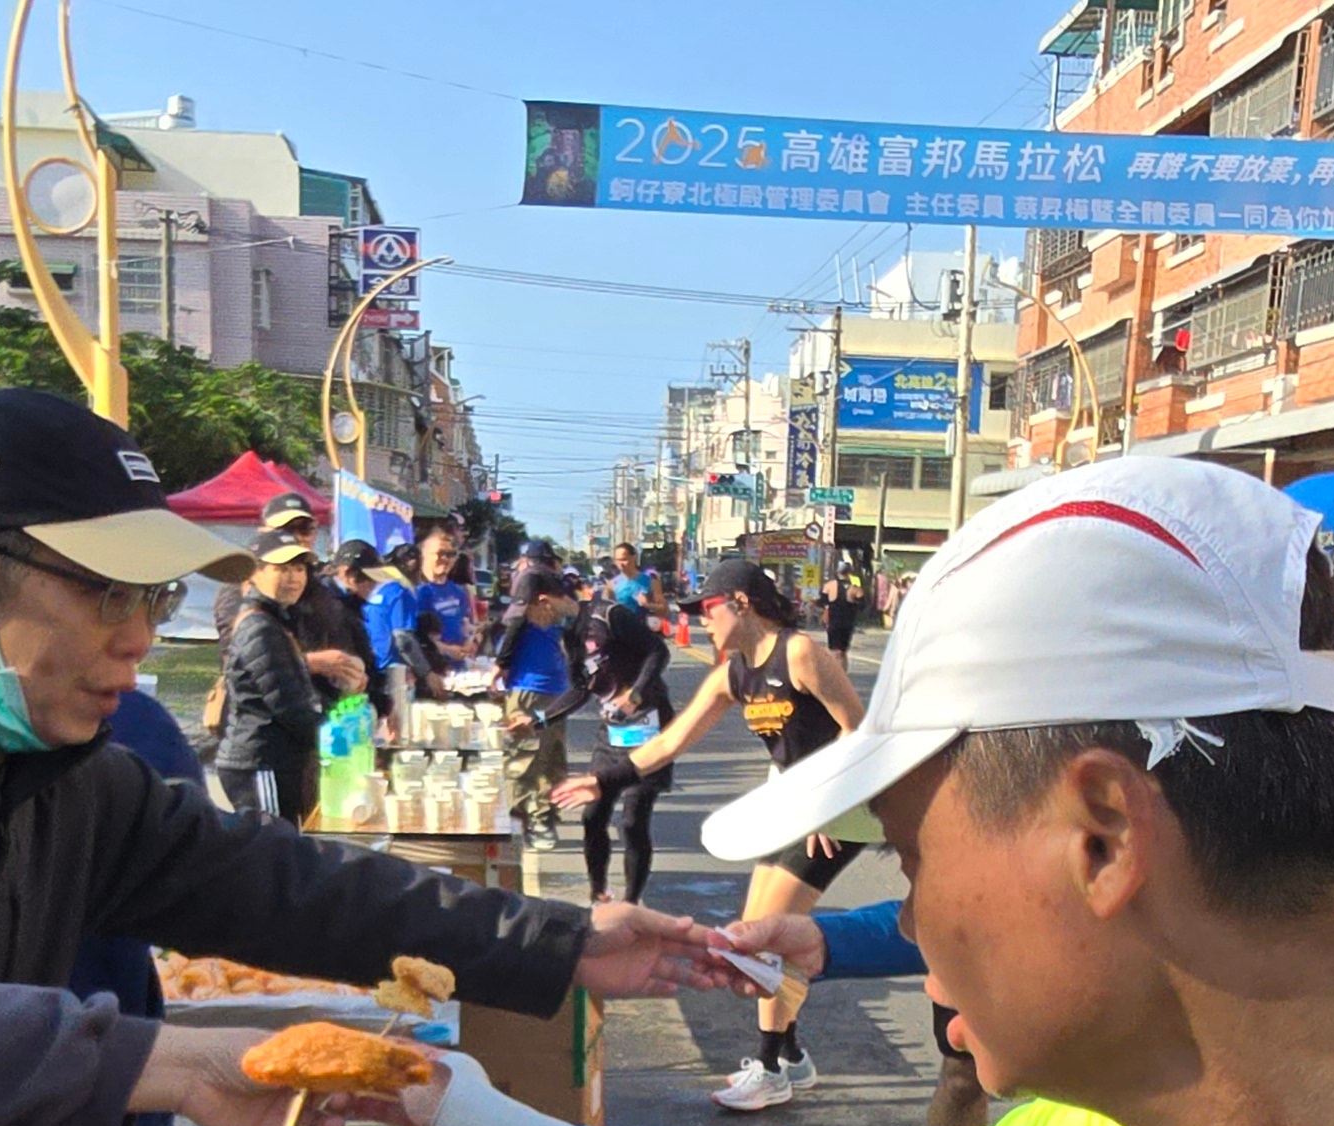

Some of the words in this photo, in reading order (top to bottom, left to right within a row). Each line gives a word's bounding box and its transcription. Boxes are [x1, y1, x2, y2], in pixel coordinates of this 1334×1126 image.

[615, 117, 765, 169] 2025
[781, 129, 1107, 184] 高雄富邦馬拉松
[609, 179, 891, 215] 蚵仔寮北極殿管理委員會
[905, 192, 1005, 220] 主任委員
